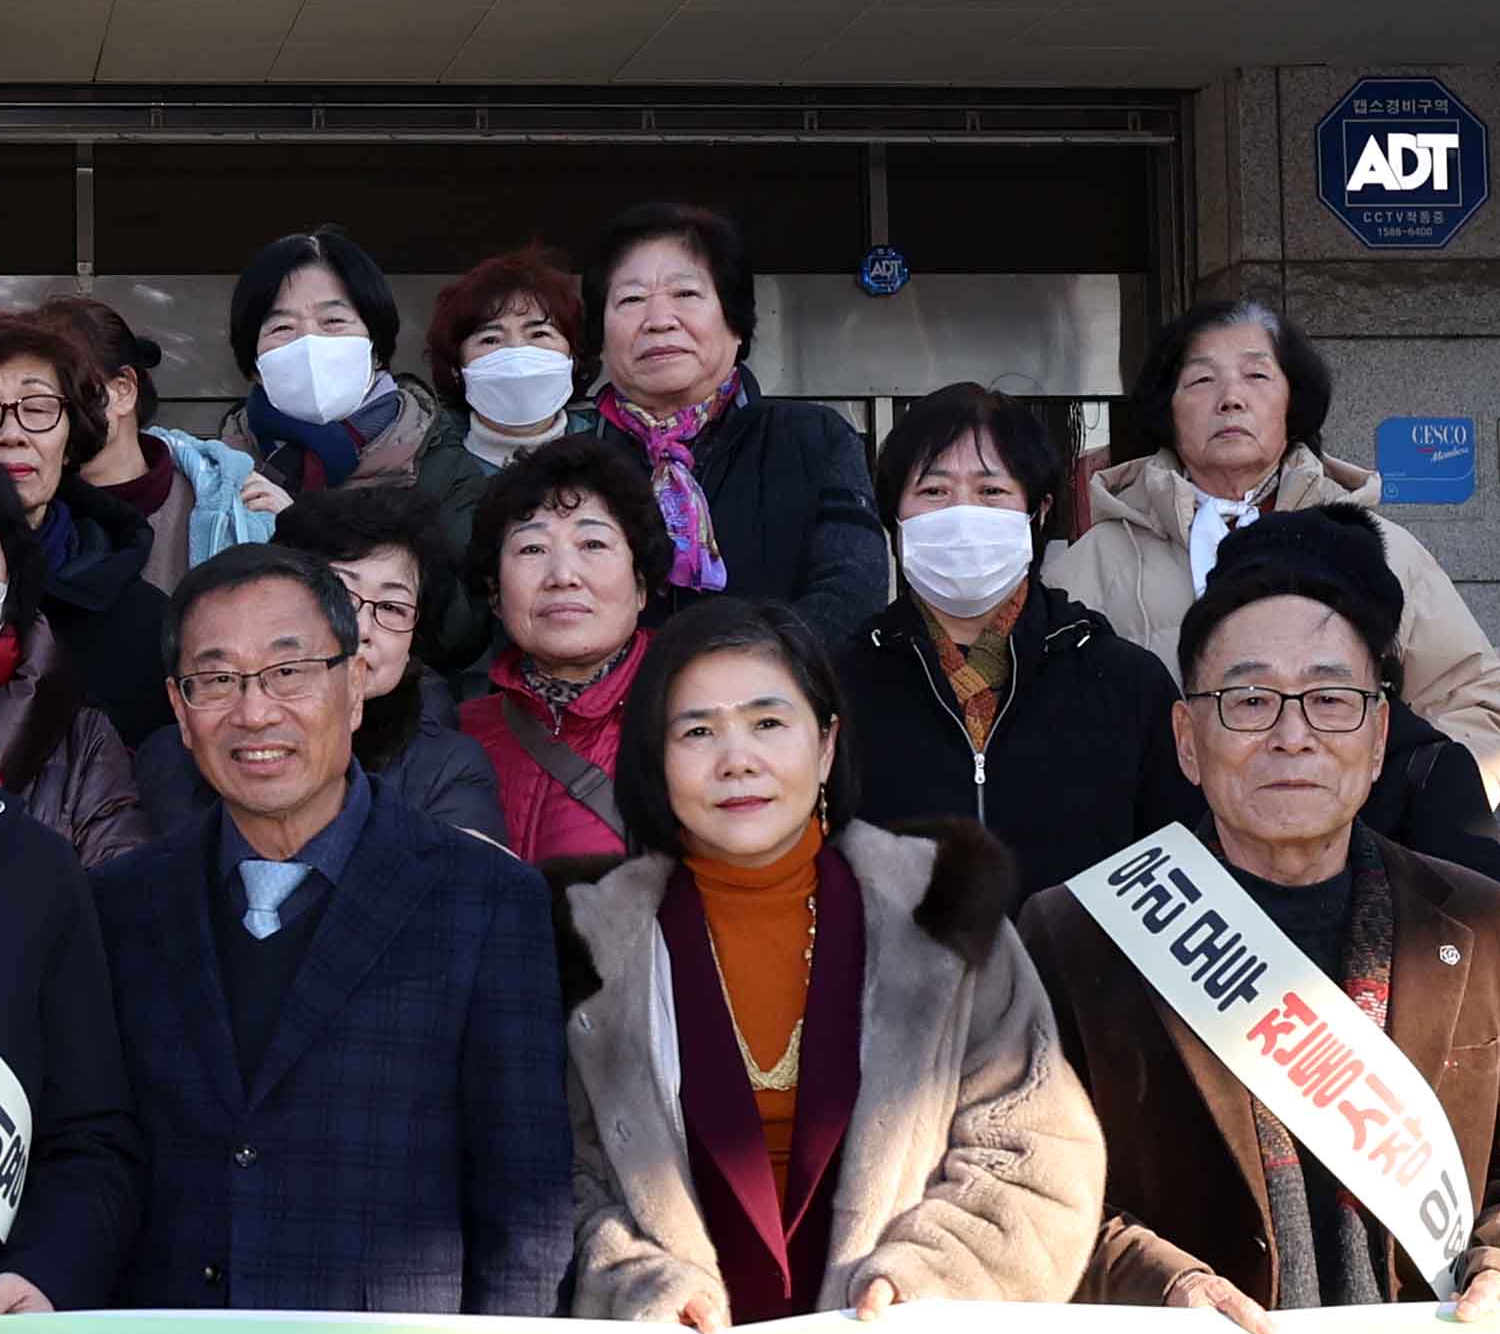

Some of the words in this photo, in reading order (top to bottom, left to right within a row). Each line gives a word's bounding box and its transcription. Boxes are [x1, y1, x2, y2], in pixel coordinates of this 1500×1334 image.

[1346, 133, 1459, 191] ADT
[870, 260, 902, 275] ADT
[1411, 424, 1467, 444] CESCO
[1107, 846, 1202, 935] 우리
[1170, 909, 1268, 1012] 모두
[1246, 991, 1433, 1186] 전통시장
